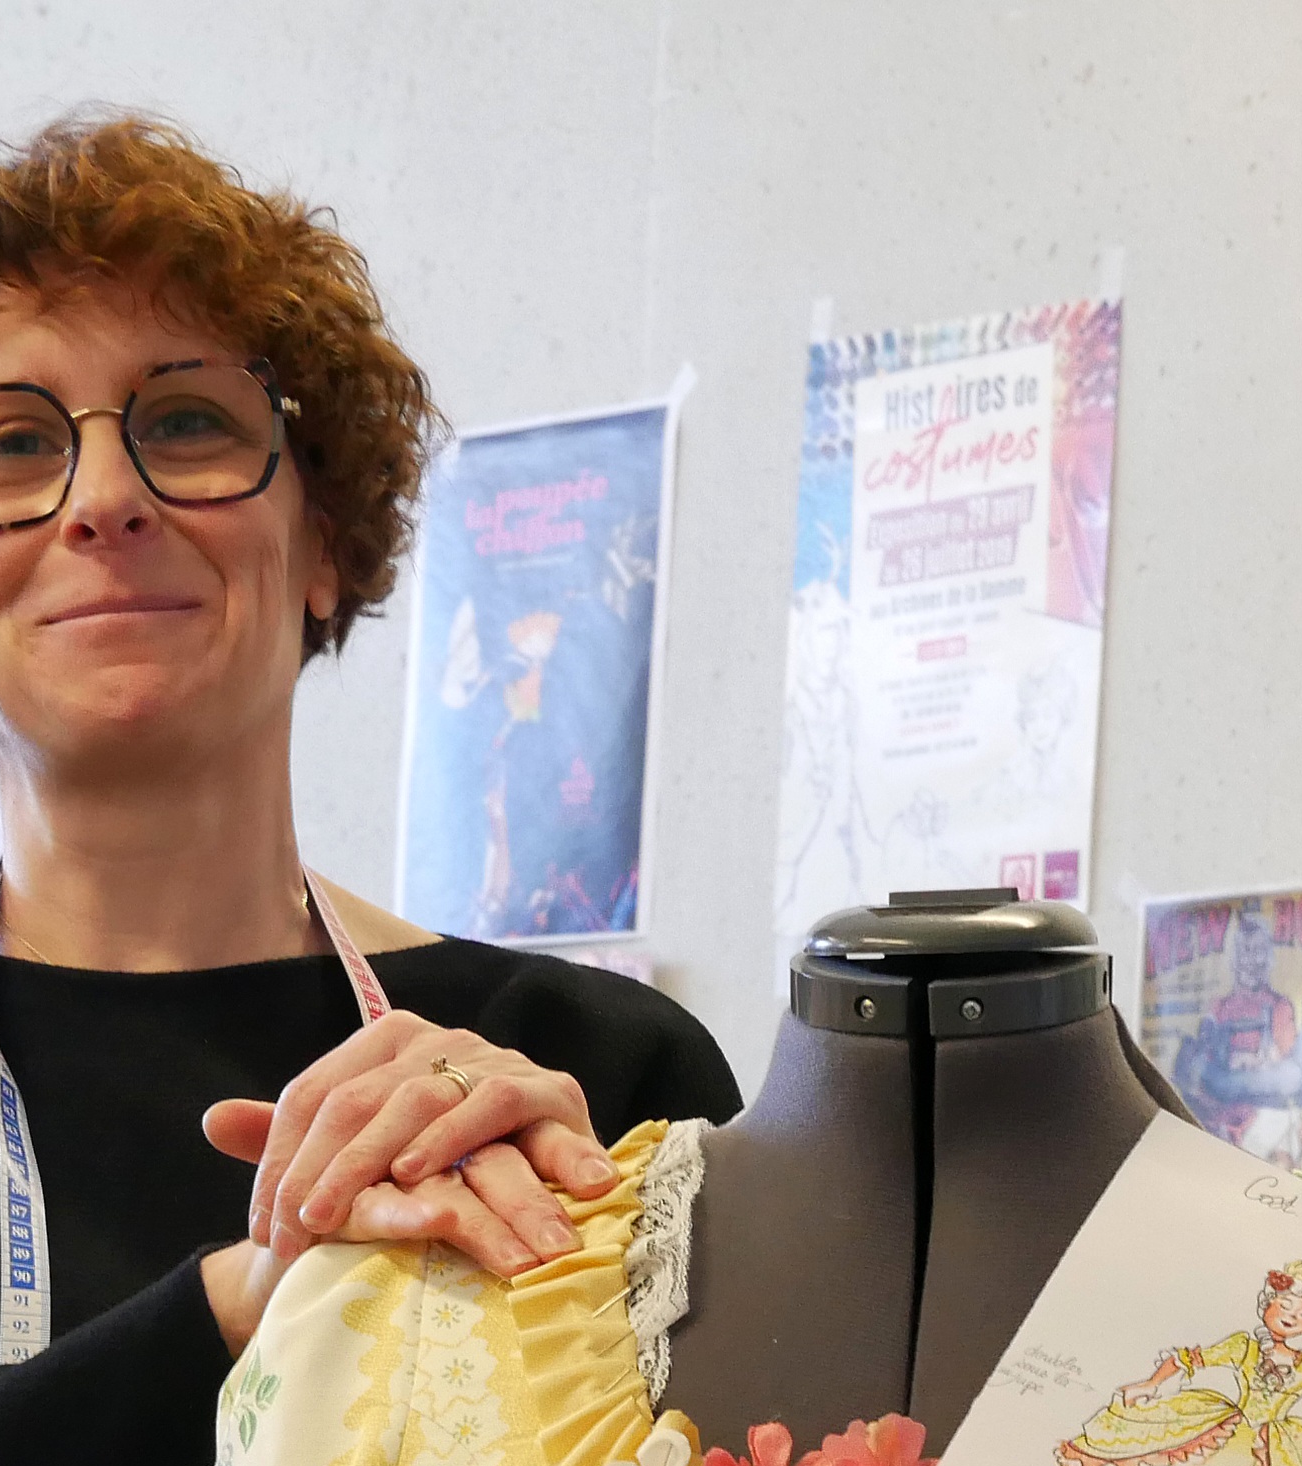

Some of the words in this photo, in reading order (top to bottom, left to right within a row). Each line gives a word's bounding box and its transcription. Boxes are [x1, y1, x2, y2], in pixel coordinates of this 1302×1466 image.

[886, 374, 1007, 430] Histoires
[1013, 375, 1039, 407] de
[864, 422, 1039, 503] costumes
[11, 1204, 29, 1218] 87
[12, 1224, 30, 1240] 88
[13, 1246, 31, 1261] 89
[14, 1269, 32, 1285] 90
[13, 1294, 30, 1308] 91
[12, 1320, 30, 1335] 92
